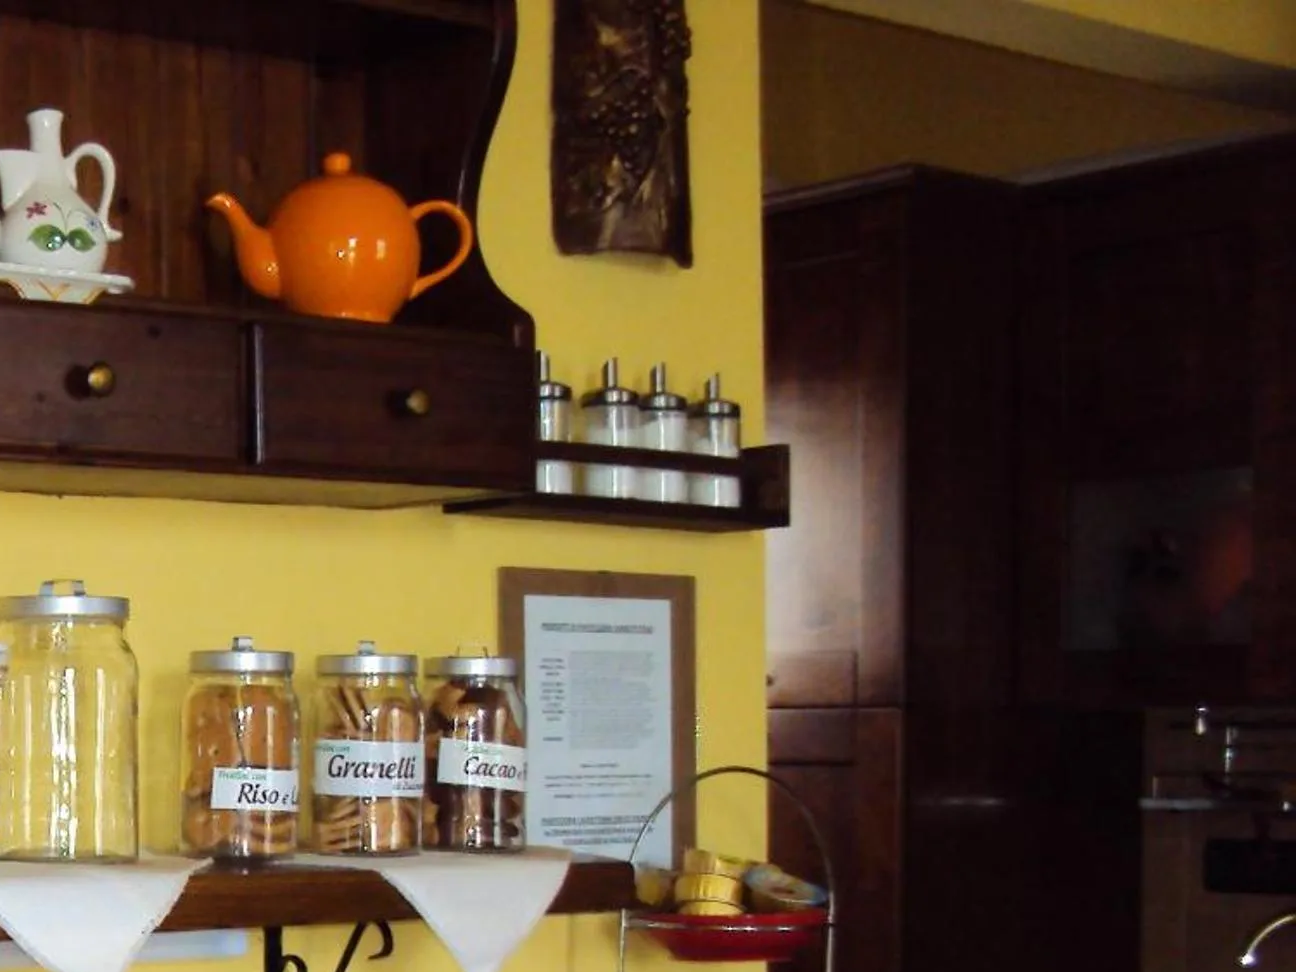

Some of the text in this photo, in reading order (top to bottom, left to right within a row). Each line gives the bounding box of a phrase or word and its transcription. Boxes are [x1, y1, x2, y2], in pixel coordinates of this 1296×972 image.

[327, 754, 417, 781] Granelli
[463, 755, 517, 779] Cacao
[237, 782, 280, 805] Riso
